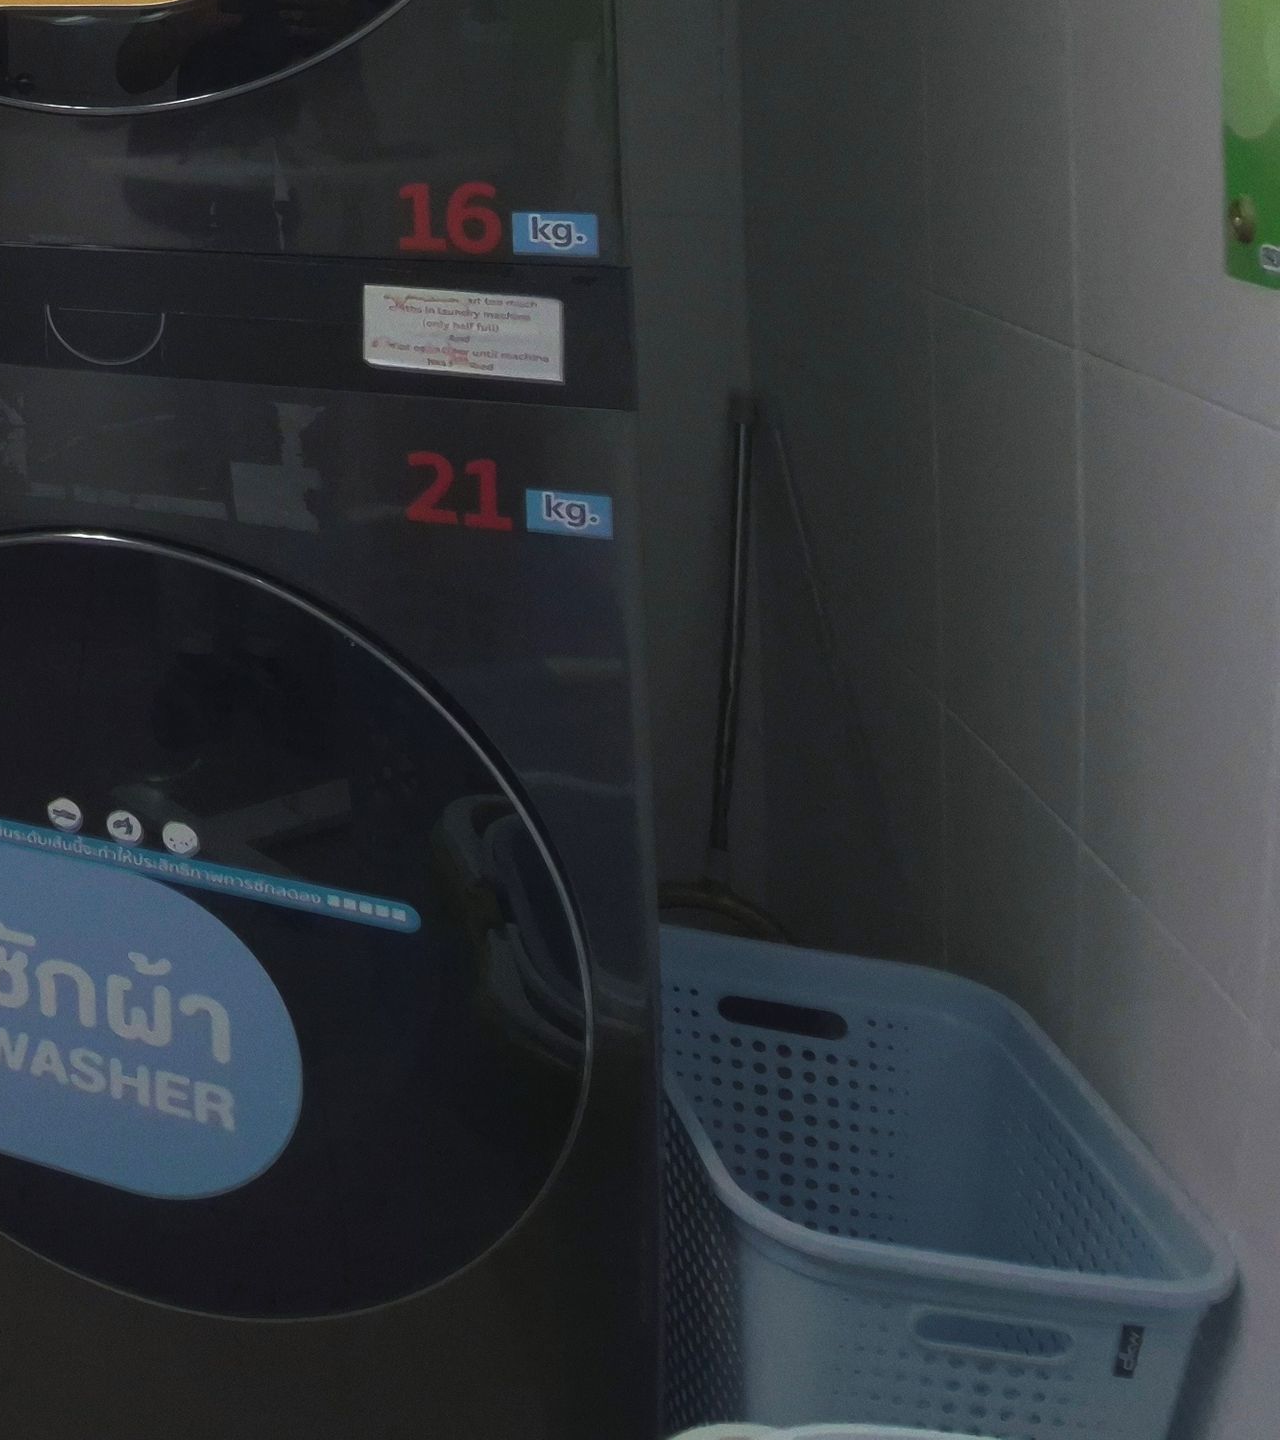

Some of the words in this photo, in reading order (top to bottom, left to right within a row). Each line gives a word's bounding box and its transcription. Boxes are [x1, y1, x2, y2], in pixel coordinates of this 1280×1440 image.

[399, 181, 502, 254] 16
[530, 214, 585, 248] kg.
[407, 450, 513, 531] 21
[544, 493, 598, 527] kg.
